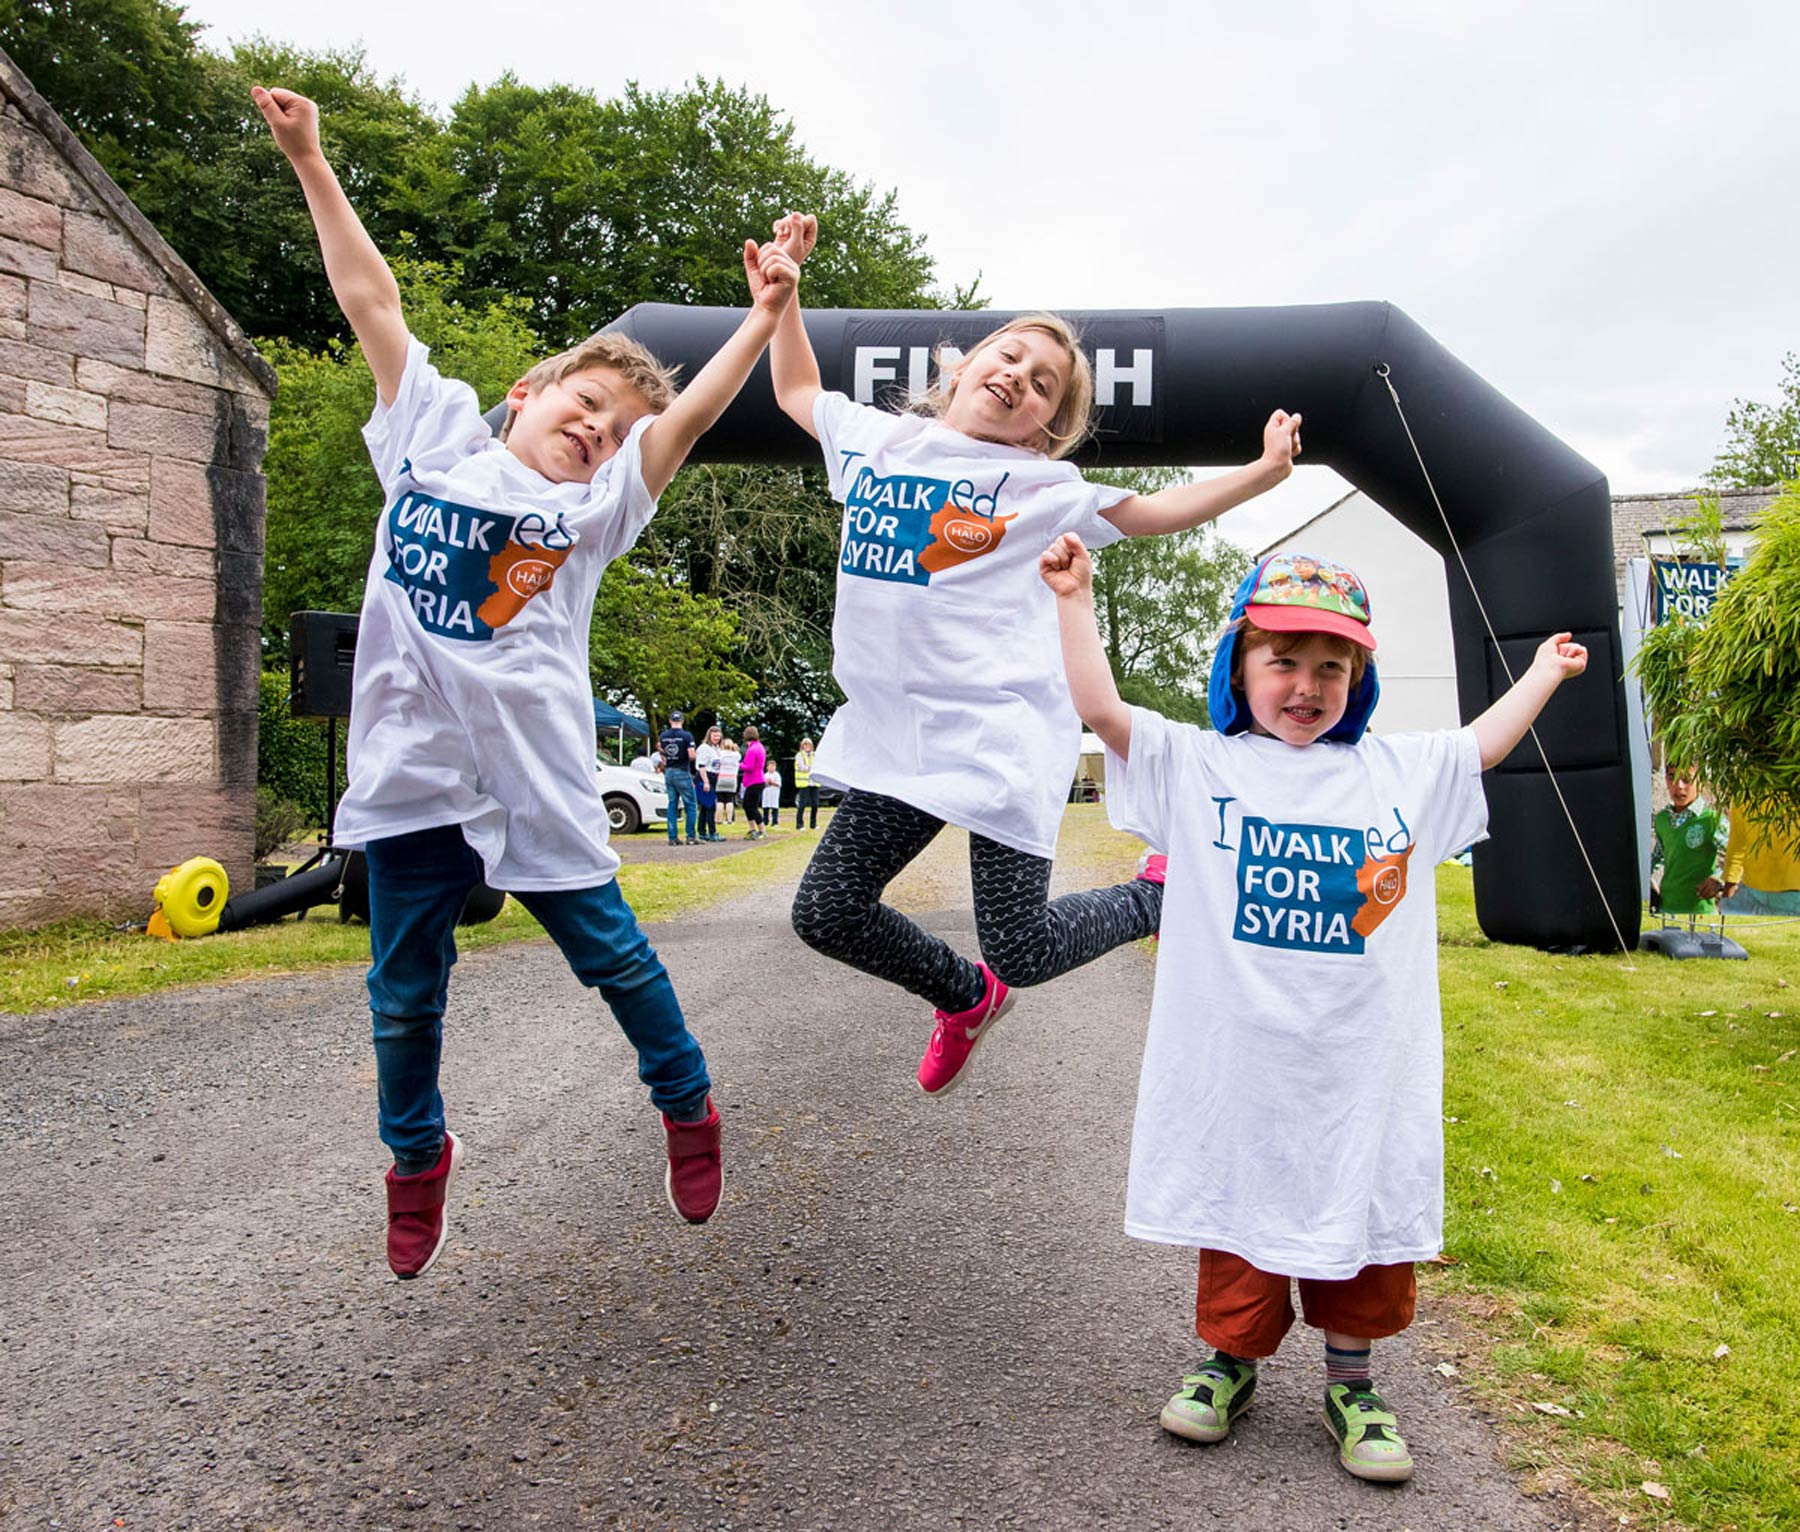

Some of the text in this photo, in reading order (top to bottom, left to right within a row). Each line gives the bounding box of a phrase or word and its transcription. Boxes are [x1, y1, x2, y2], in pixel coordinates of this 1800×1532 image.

[854, 346, 1153, 405] FIH
[856, 474, 935, 511] WALK
[951, 471, 1010, 524] ed
[397, 496, 495, 551] WALK
[848, 505, 899, 538] FOR
[951, 526, 985, 542] HALO
[393, 534, 449, 586] FOR
[1661, 567, 1729, 591] WALK
[1663, 594, 1709, 616] FOR
[1211, 796, 1411, 866] I WALK ed
[1244, 864, 1321, 902] FOR
[1241, 902, 1350, 945] SYRIA
